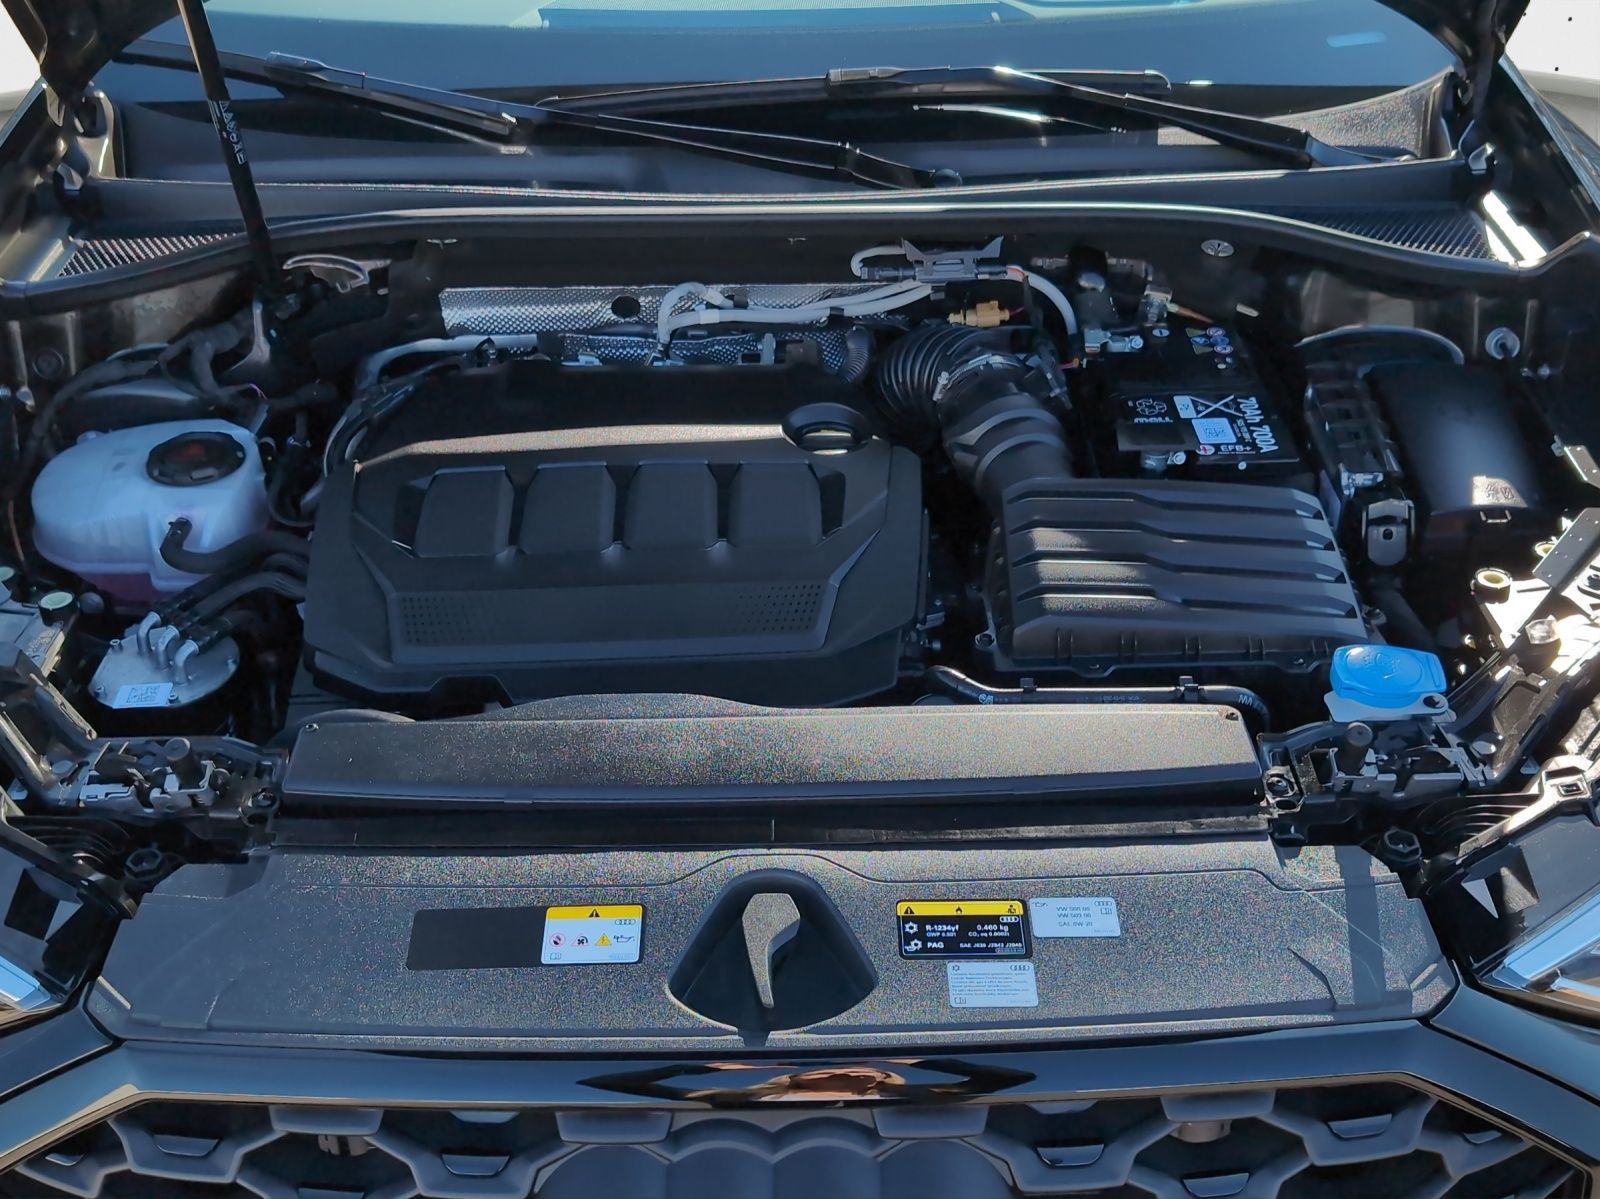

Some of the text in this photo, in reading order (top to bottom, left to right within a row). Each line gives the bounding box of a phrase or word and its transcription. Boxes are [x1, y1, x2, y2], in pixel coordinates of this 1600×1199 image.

[1238, 397, 1264, 423] 70Ah
[1250, 426, 1278, 453] 700A
[1219, 444, 1253, 452] EFB+
[925, 924, 959, 932] R-1234yf
[999, 923, 1009, 932] kg
[927, 941, 944, 949] PAG
